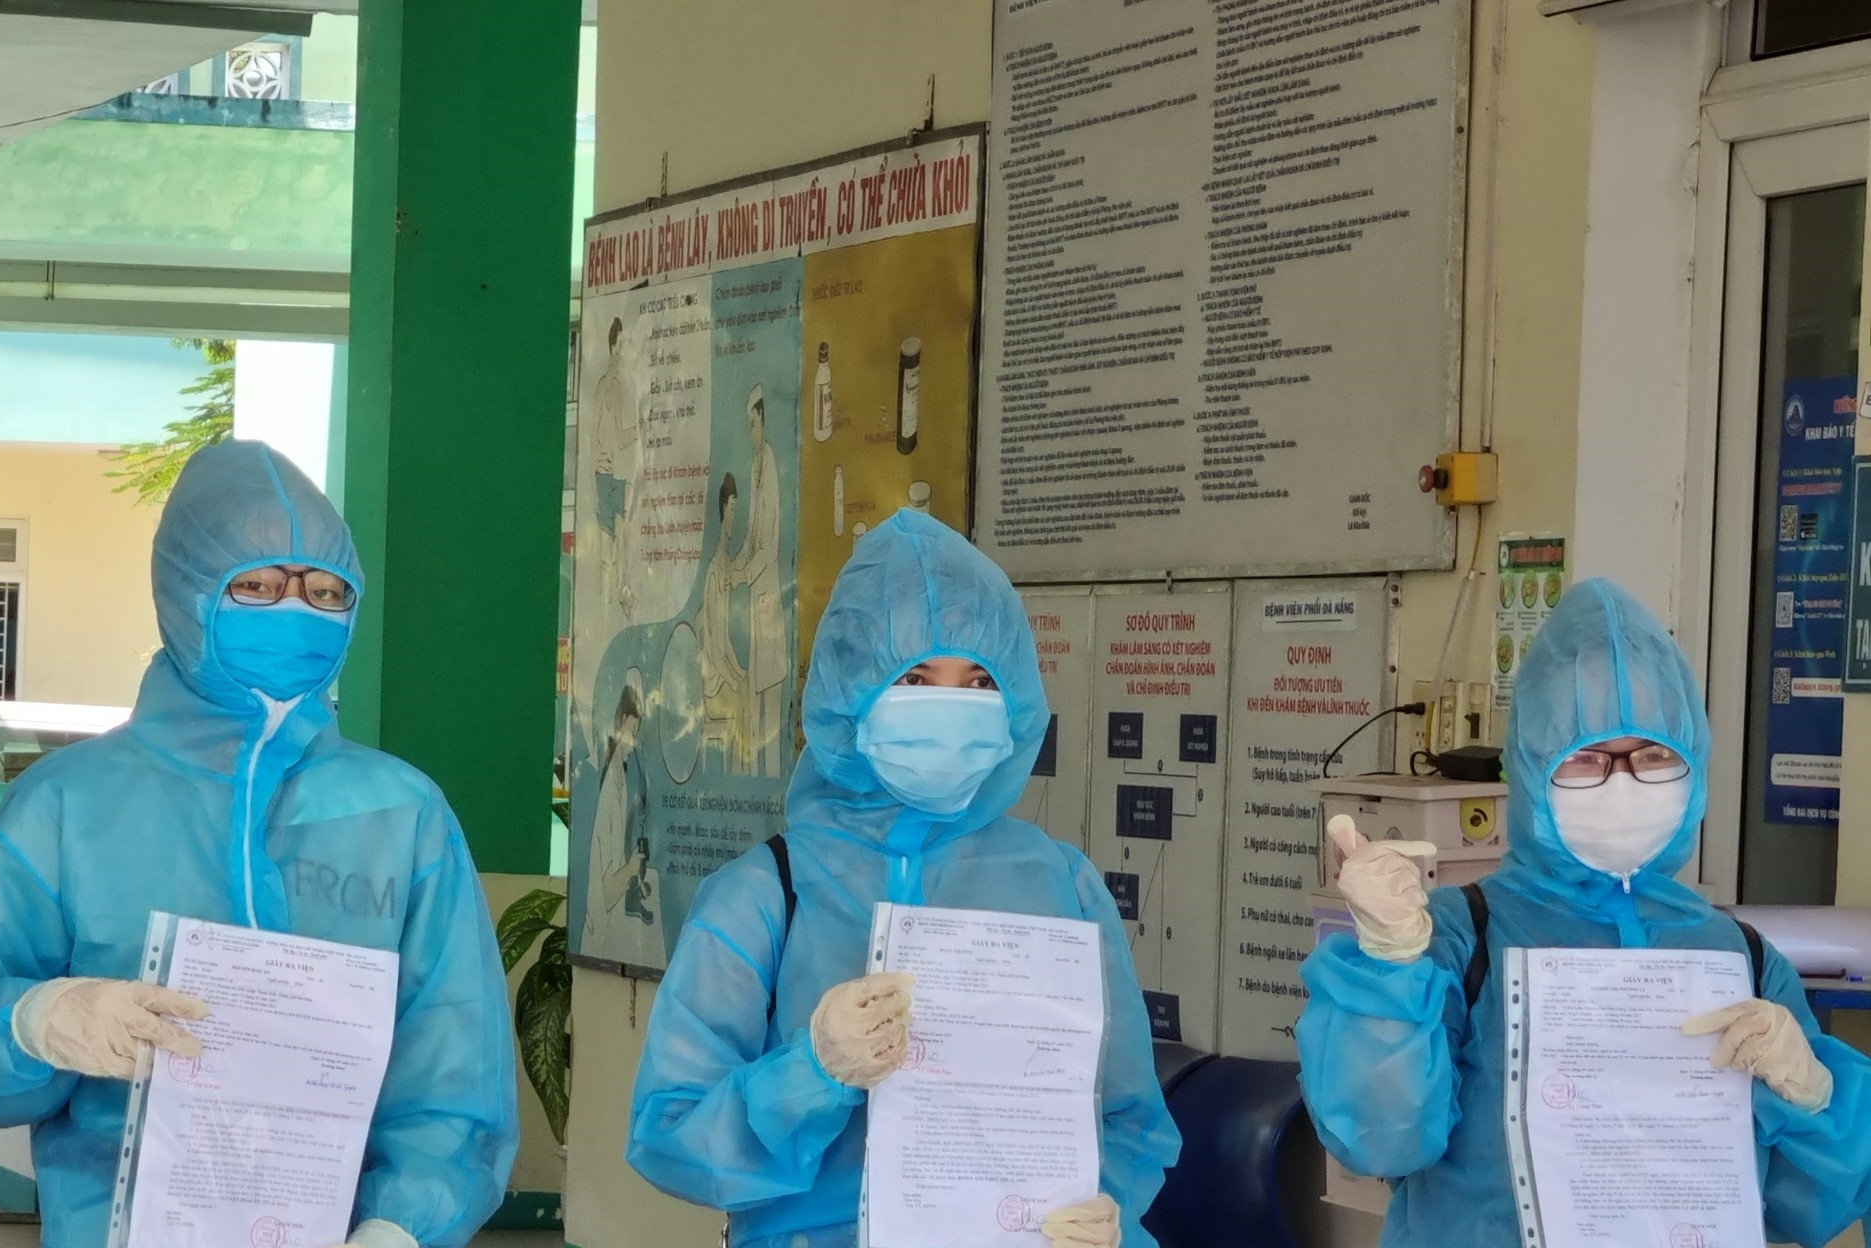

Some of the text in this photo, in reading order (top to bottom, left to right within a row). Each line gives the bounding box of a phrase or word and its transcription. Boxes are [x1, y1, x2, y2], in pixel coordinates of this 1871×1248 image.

[588, 232, 616, 294] BỆNH
[619, 230, 639, 282] LAO
[641, 218, 653, 276] LÀ
[657, 215, 686, 281] BỆNH
[717, 197, 758, 260] KHÔNG
[762, 198, 775, 251] DI
[779, 176, 831, 248] TRUYỀN,
[837, 167, 856, 236] CÓ
[860, 156, 888, 231] THỂ
[932, 139, 970, 218] KHỎI
[1839, 426, 1844, 438] Y
[1265, 602, 1283, 618] BỆNH
[1286, 601, 1302, 617] VIỆN
[1322, 600, 1332, 614] ĐÀ
[1126, 611, 1195, 633] SƠ QUY TRÌNH
[1288, 646, 1331, 669] QUY ĐỊNH
[1274, 675, 1287, 691] ĐỐI
[1326, 676, 1342, 693] TIÊN
[1247, 694, 1370, 717] KHI ĐẾN KHÁM BỆNH THUỐC
[1248, 747, 1253, 759] 1.
[1254, 746, 1269, 762] Bệnh
[1244, 802, 1294, 818] 2. Người cao tuổi
[1244, 837, 1249, 848] 3.
[1250, 837, 1269, 852] Người
[1293, 841, 1307, 854] cách
[1243, 872, 1248, 883] 4.
[1259, 877, 1268, 886] em
[1285, 877, 1289, 886] 6
[1290, 875, 1302, 890] tuổi
[1242, 907, 1247, 920] 5.
[1248, 908, 1259, 924] Phụ
[1292, 914, 1304, 925] cho
[991, 940, 1001, 948] RA
[1240, 943, 1246, 954] 6.
[1246, 942, 1262, 959] Bệnh
[289, 962, 296, 970] RA
[1239, 978, 1244, 990] 7.
[1245, 978, 1261, 994] Bệnh
[1262, 980, 1271, 992] do
[1272, 981, 1287, 998] bệnh
